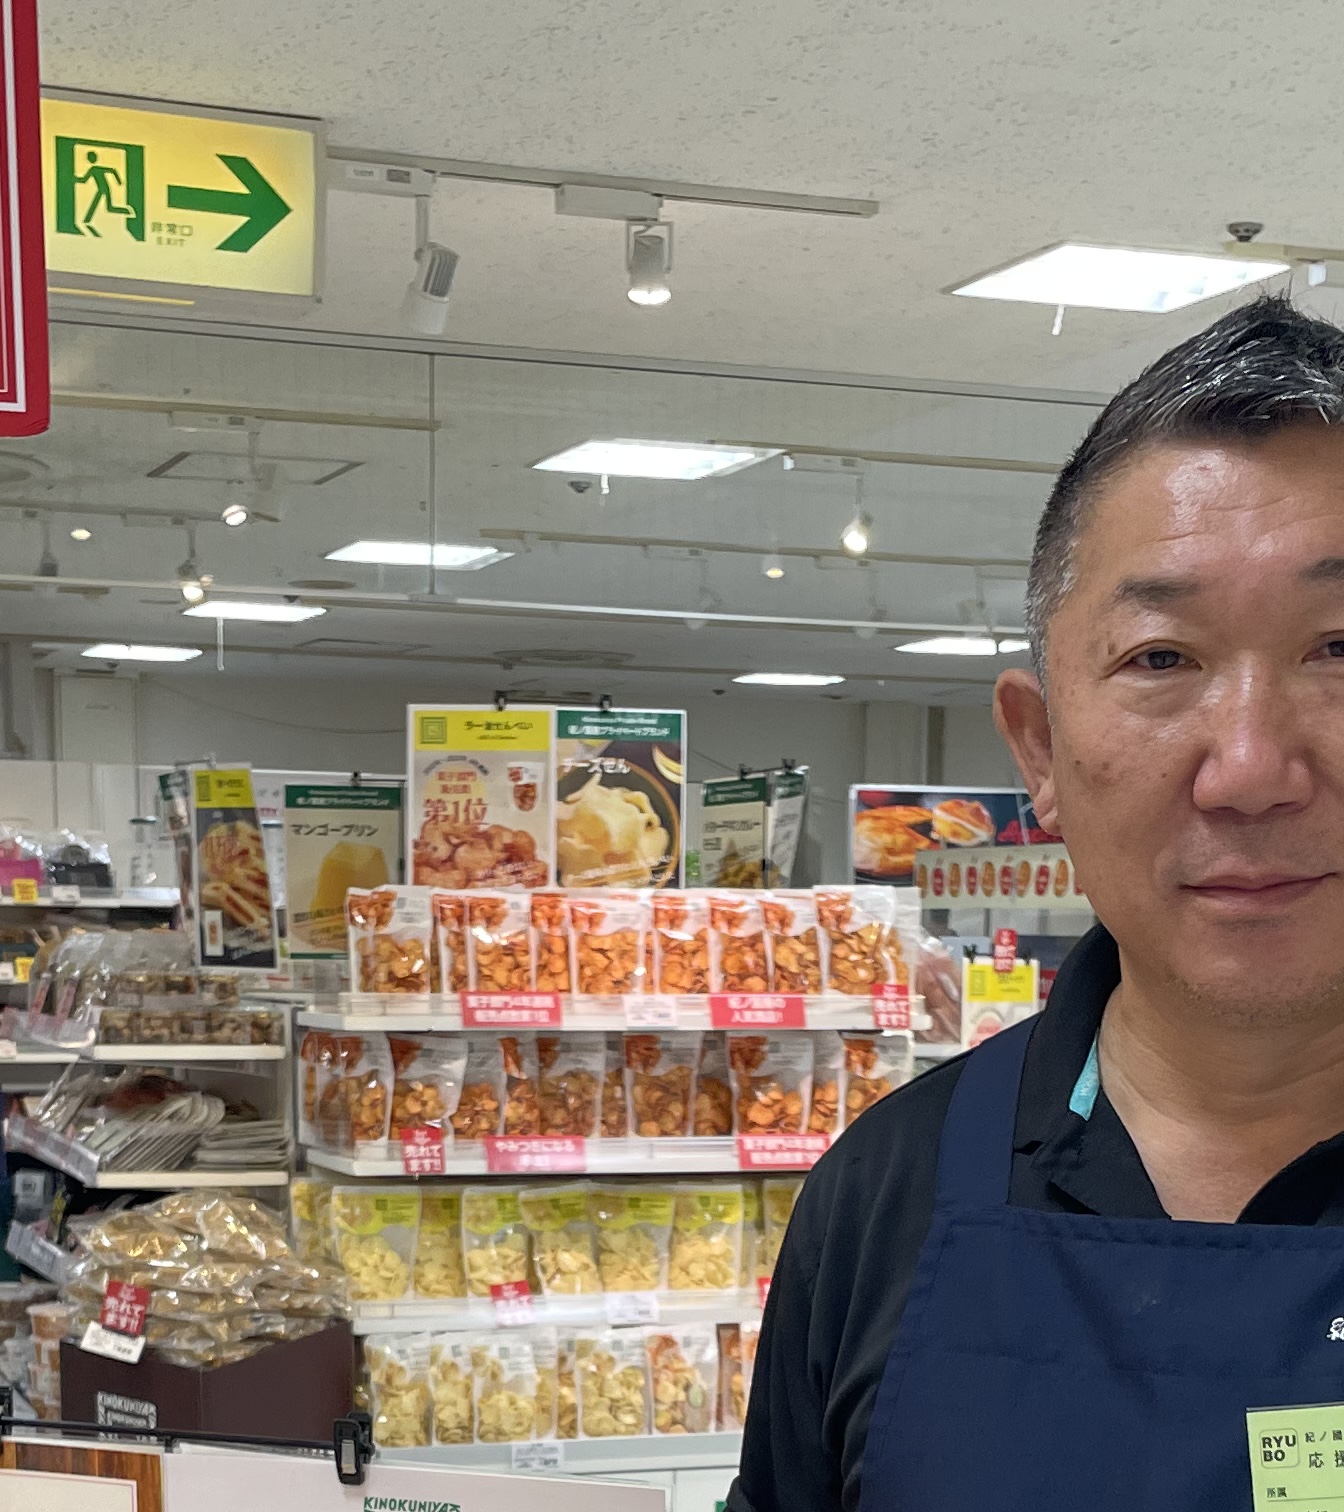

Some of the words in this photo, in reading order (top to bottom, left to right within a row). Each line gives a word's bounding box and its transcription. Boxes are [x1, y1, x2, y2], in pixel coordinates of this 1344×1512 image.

[156, 237, 185, 247] EXIT
[1261, 1435, 1297, 1449] RYU
[1263, 1450, 1286, 1463] BO
